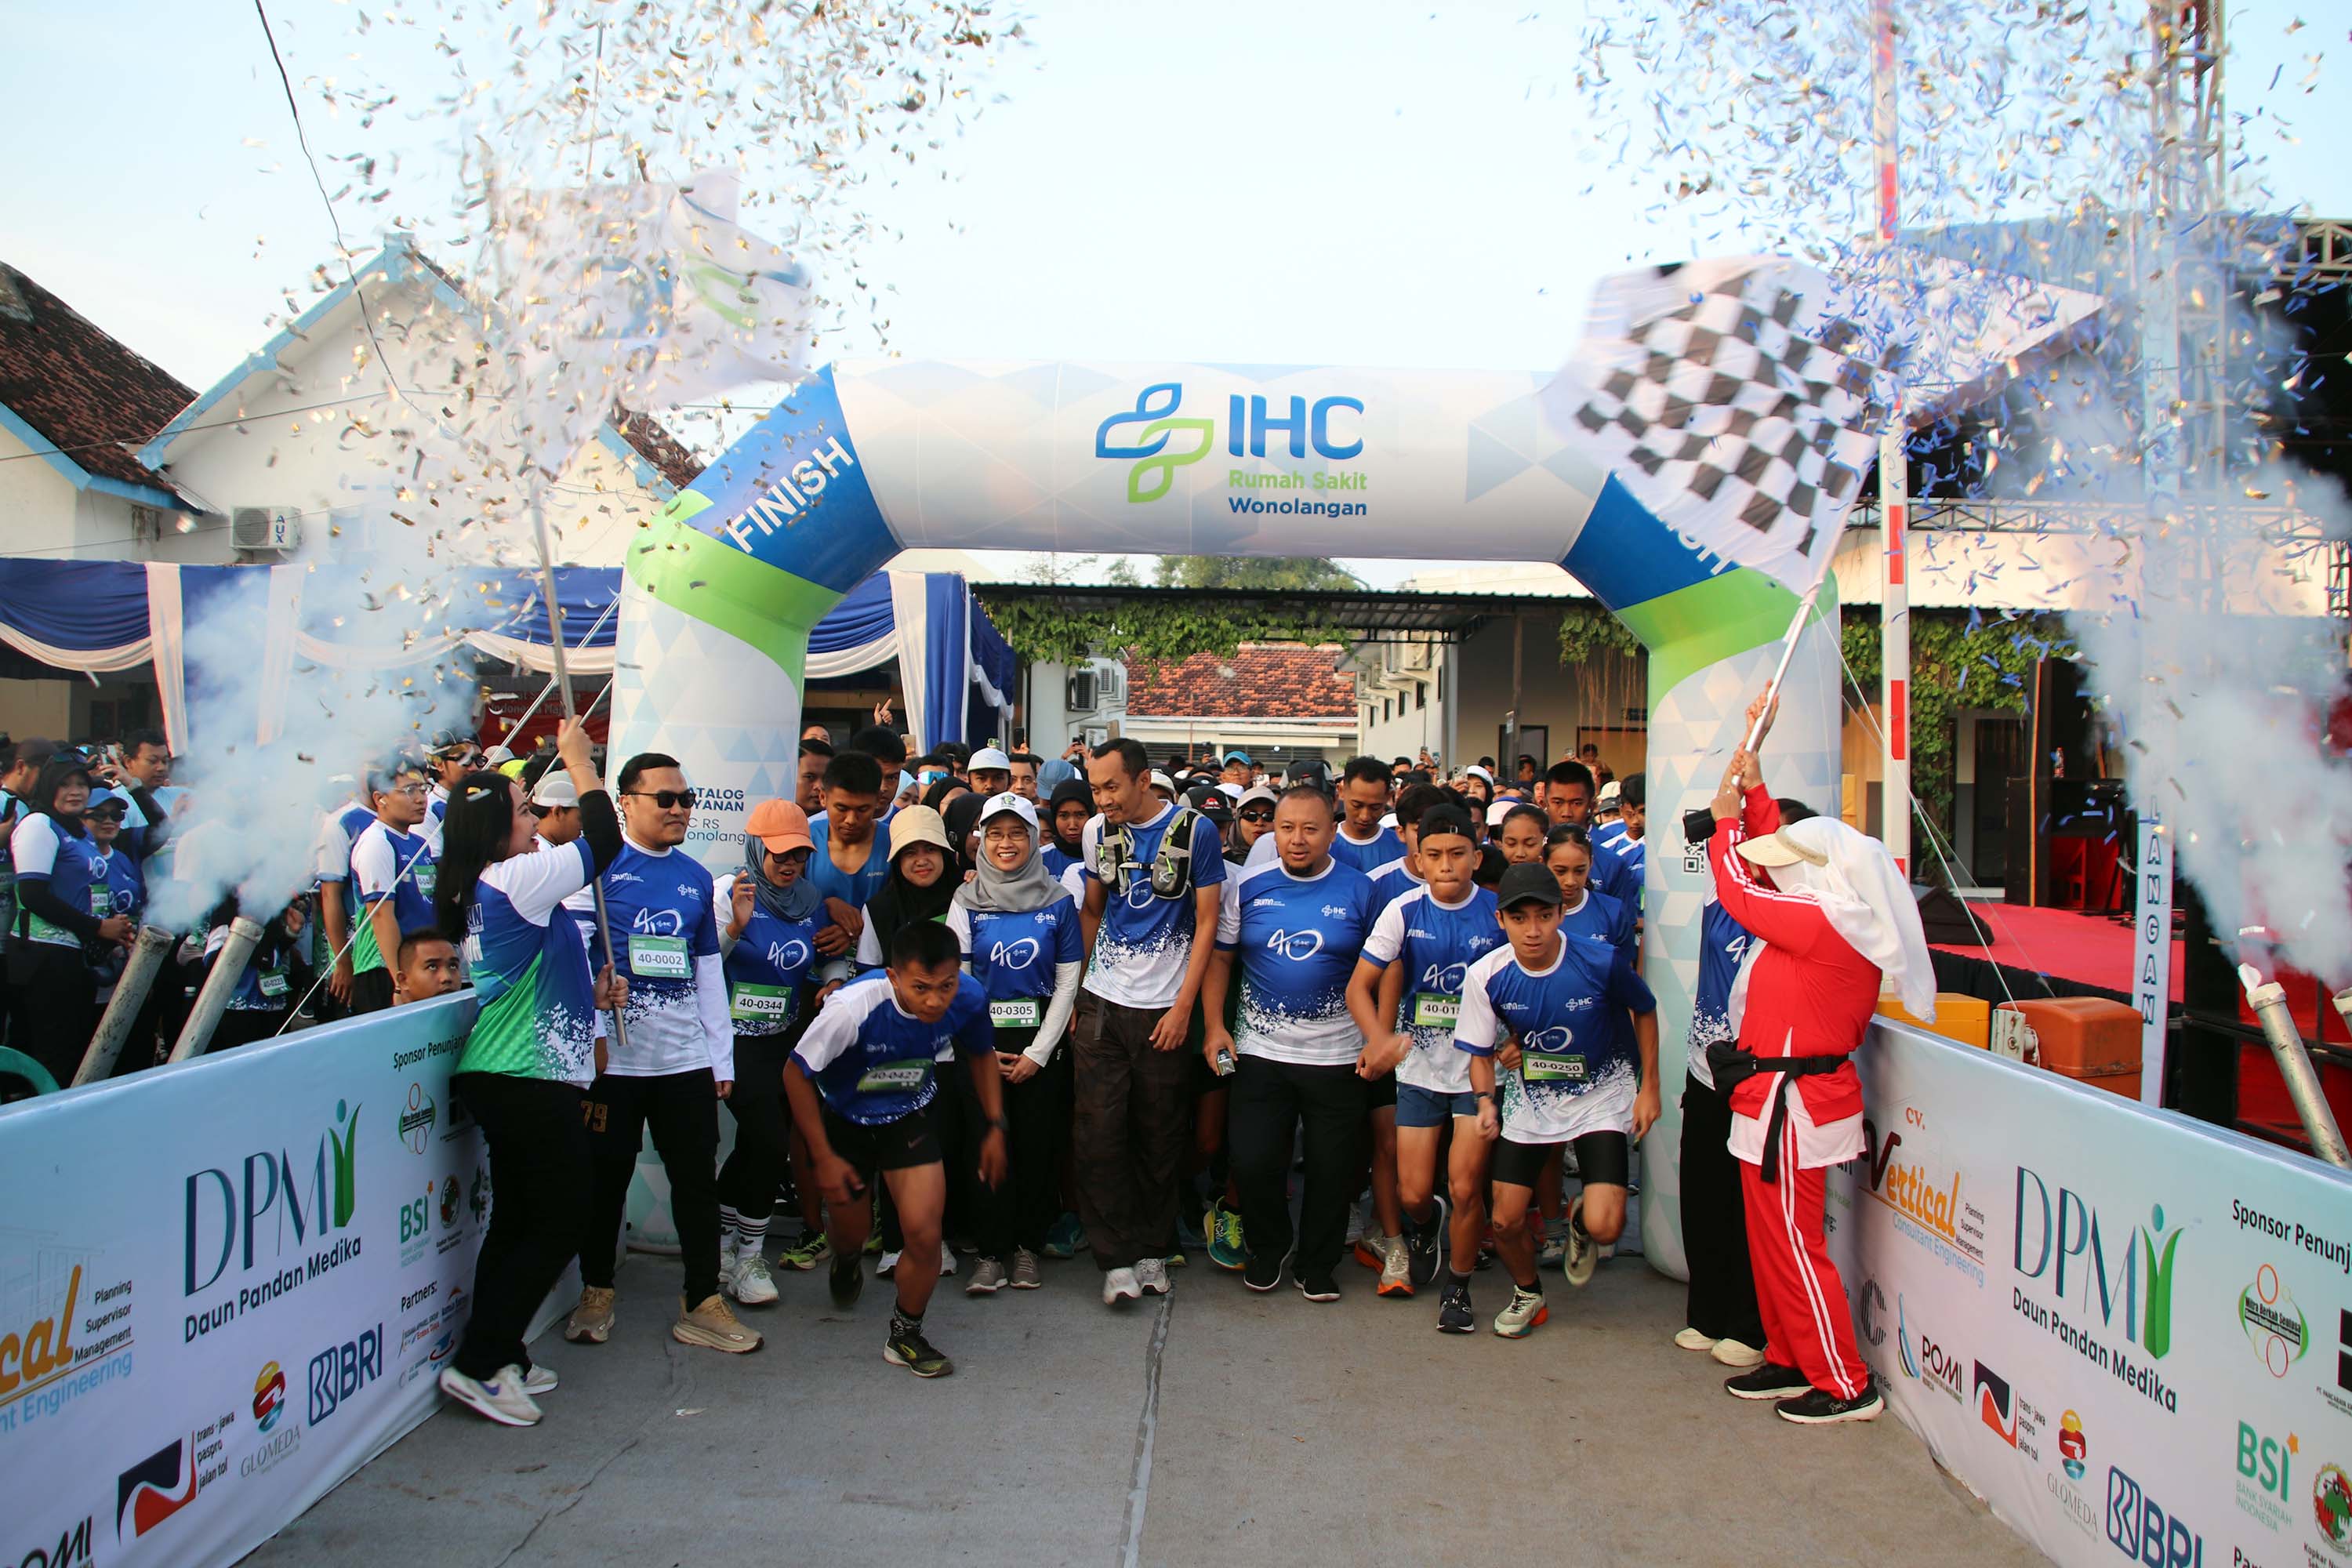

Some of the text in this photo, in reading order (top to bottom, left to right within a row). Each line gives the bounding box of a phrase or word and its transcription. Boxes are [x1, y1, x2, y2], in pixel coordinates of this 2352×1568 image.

[1229, 394, 1364, 460] IHC
[726, 435, 854, 554] FINISH
[1229, 470, 1367, 492] Rumah Sakit
[1229, 497, 1367, 518] Wonolangan
[275, 514, 285, 544] AUX
[688, 787, 744, 800] ATALOG
[693, 800, 744, 811] YANAN
[688, 830, 745, 844] onolang
[702, 818, 720, 829] RS
[638, 953, 684, 965] 40-0002
[739, 997, 783, 1011] 40-0344
[989, 1006, 1033, 1015] 40-0305
[1577, 997, 1593, 1007] IHC
[394, 1047, 426, 1072] Sponsor
[1532, 1061, 1580, 1072] 40-0250
[581, 1100, 608, 1132] 79
[1859, 1119, 1960, 1238] Vertical
[401, 1195, 428, 1243] BSI
[1961, 1218, 1984, 1240] Supervisor
[1965, 1203, 1984, 1225] Planning
[1893, 1212, 1984, 1288] Consultant Engineering
[1955, 1234, 1984, 1259] Management
[2233, 1199, 2352, 1275] Sponsor Penunj
[95, 1279, 132, 1305] Planning
[185, 1299, 234, 1343] Daun
[239, 1267, 304, 1308] Pandan
[307, 1236, 361, 1289] Medika
[401, 1280, 437, 1312] Partners:
[85, 1303, 132, 1334] Supervisor
[74, 1327, 132, 1363] Management
[2013, 1287, 2176, 1414] Daun Pandan Medika
[339, 1323, 383, 1402] BRI
[1922, 1335, 1962, 1393] POMI
[23, 1351, 132, 1424] Engineering
[2019, 1397, 2031, 1414] trans
[2034, 1406, 2045, 1426] jawa
[2019, 1415, 2035, 1436] paspro
[198, 1424, 214, 1443] trans
[219, 1411, 234, 1434] jawa
[198, 1439, 223, 1466] paspro
[241, 1425, 300, 1478] GLOMEDA
[2018, 1437, 2031, 1456] jalan
[2237, 1420, 2289, 1503] BSI
[198, 1456, 228, 1494] jalan tol
[2047, 1473, 2097, 1531] GLOMEDA
[2235, 1497, 2278, 1533] INDONESIA
[2236, 1479, 2292, 1527] BANK SYARIAH
[2303, 1541, 2327, 1565] Kopkar
